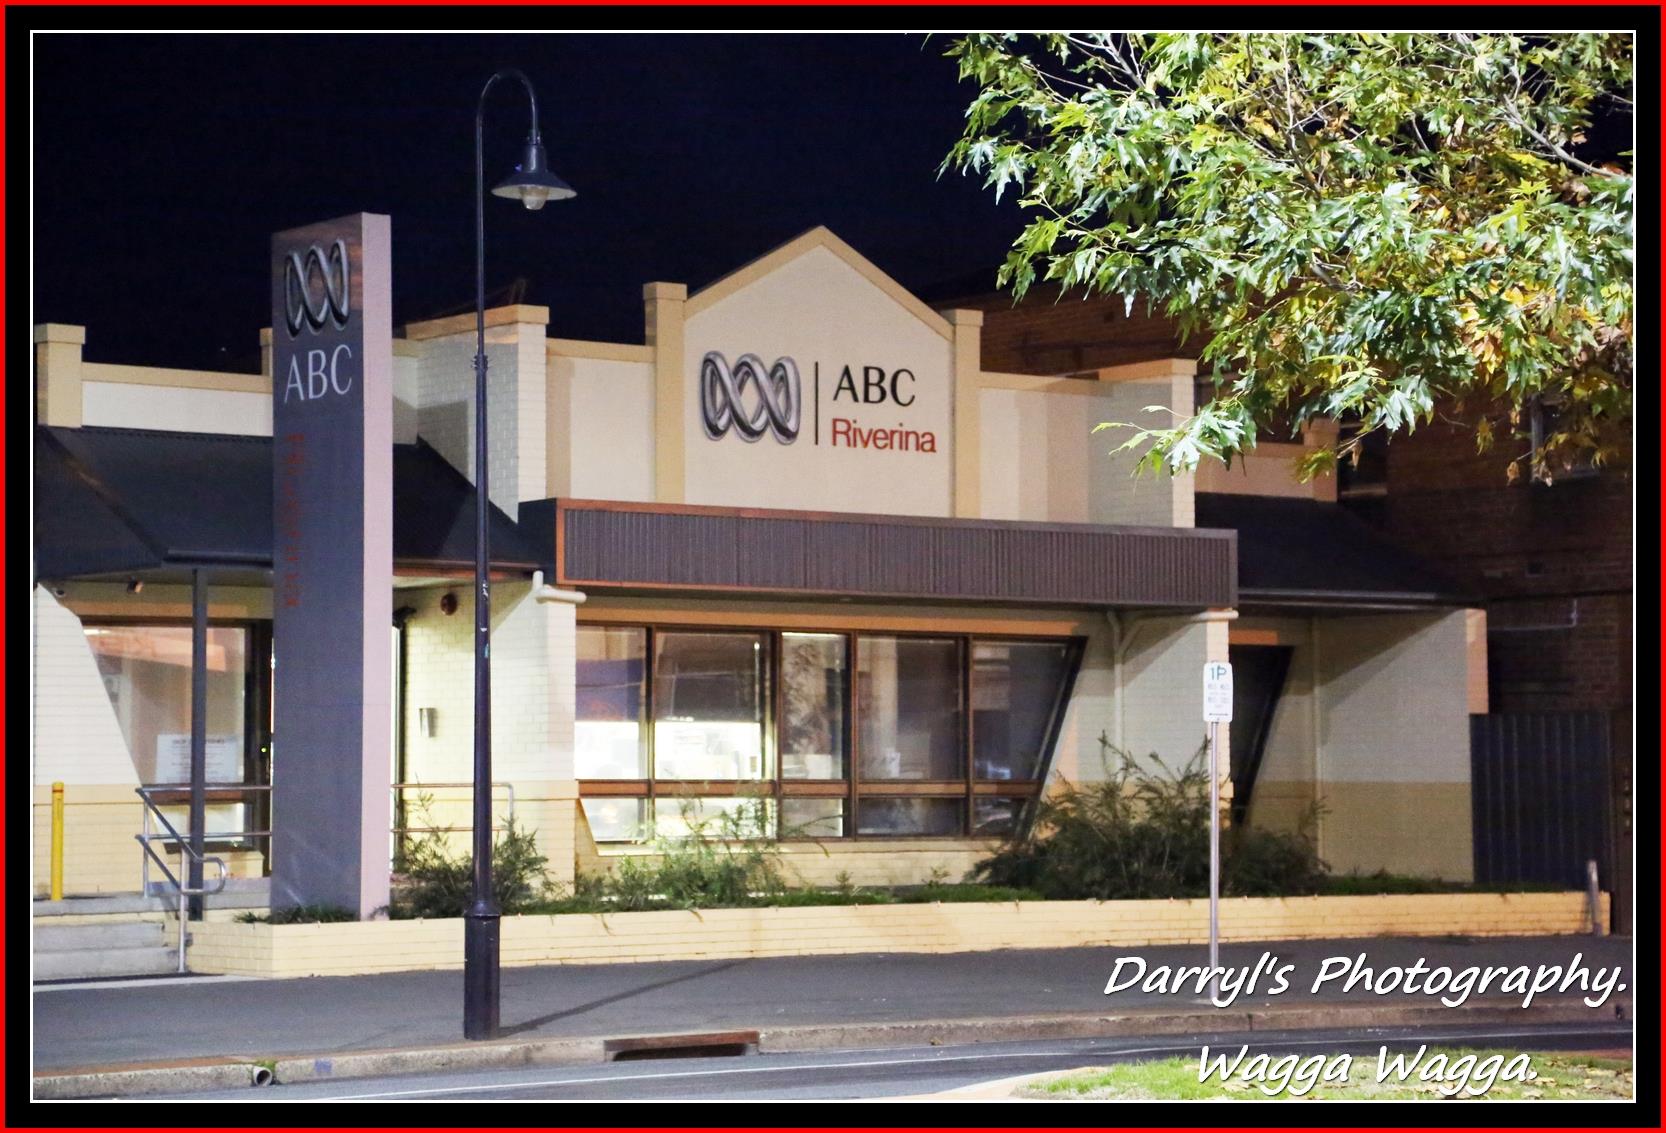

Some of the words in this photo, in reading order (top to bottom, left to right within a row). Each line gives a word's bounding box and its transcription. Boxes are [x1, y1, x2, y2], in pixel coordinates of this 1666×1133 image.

[285, 344, 352, 404] ABC
[833, 364, 916, 407] ABC
[831, 418, 937, 453] Riverina
[1210, 665, 1227, 680] 1P
